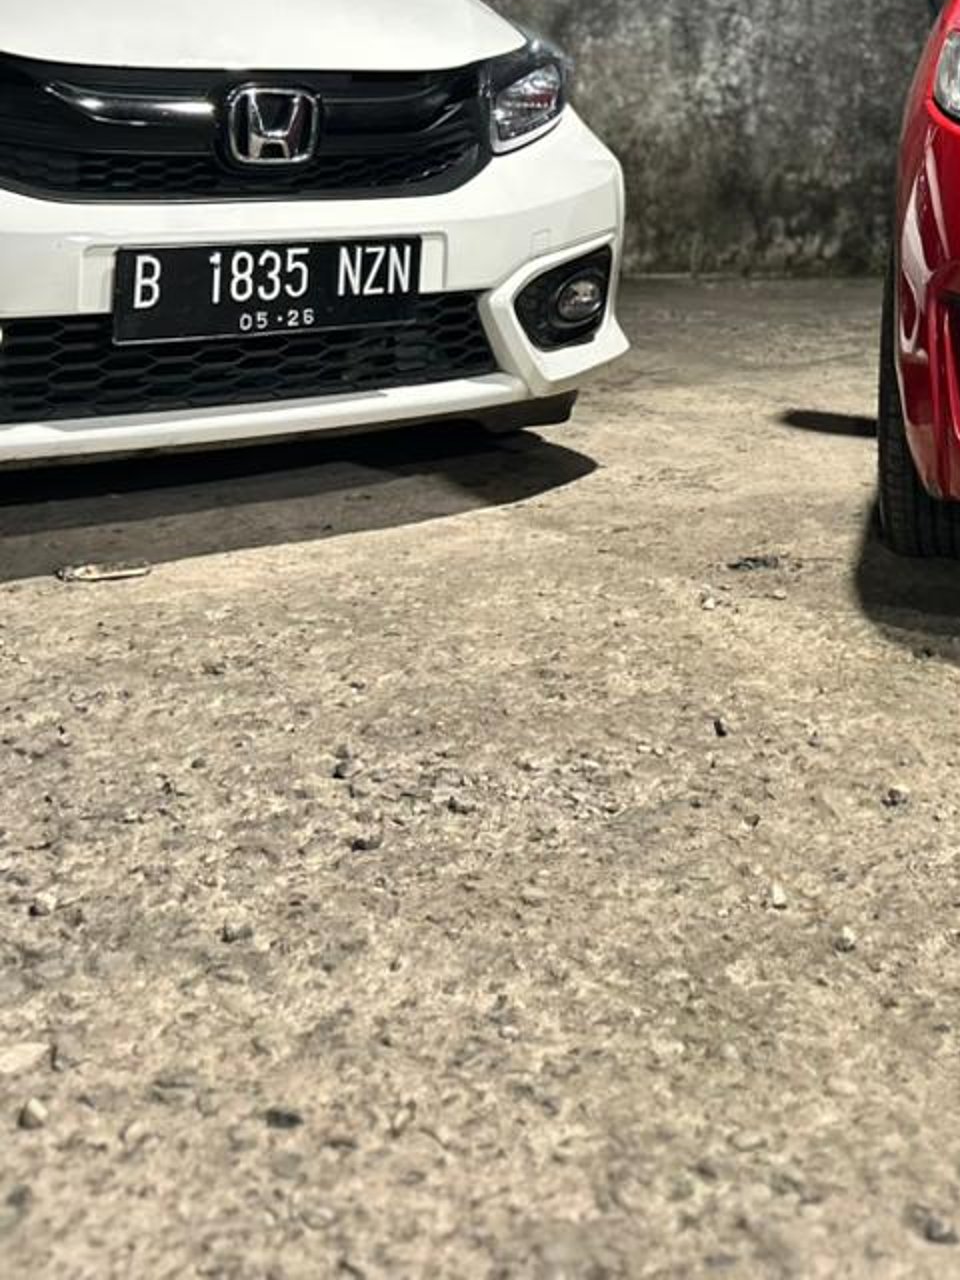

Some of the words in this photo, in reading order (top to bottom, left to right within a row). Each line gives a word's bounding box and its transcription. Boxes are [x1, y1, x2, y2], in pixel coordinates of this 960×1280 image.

[133, 255, 161, 309] B
[209, 248, 309, 303] 1835
[337, 245, 412, 296] NZN
